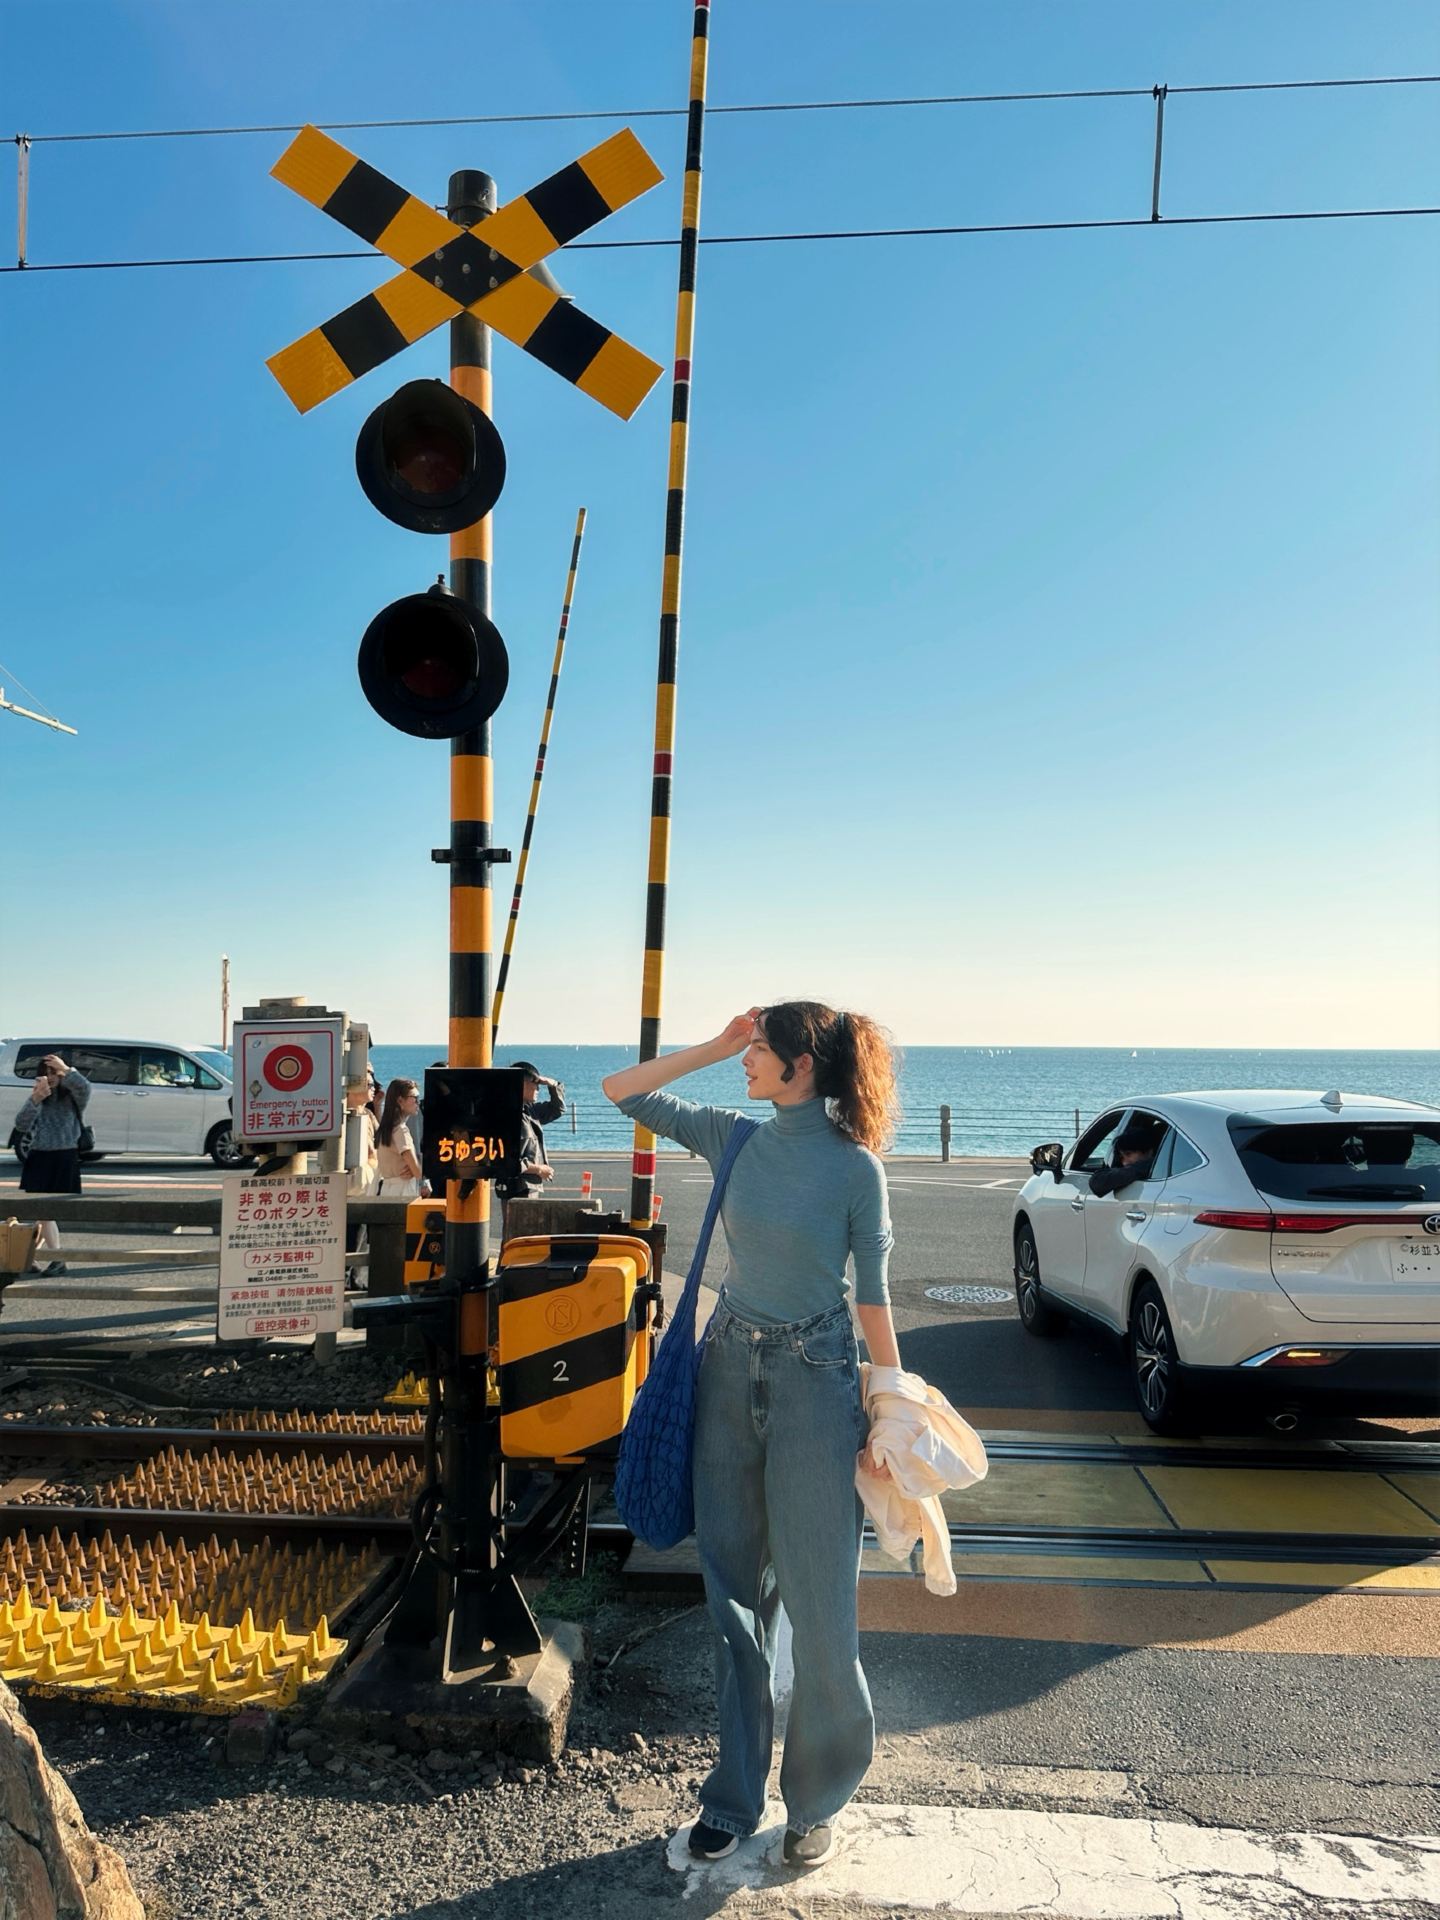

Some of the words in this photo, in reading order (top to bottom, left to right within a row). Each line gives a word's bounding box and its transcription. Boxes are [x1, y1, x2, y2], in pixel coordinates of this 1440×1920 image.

[249, 1100, 297, 1110] Emergency
[301, 1098, 329, 1106] button
[247, 1109, 329, 1130] 非常ボタン
[438, 1136, 505, 1163] ちゅうい
[239, 1189, 328, 1206] 非常の際は
[237, 1205, 330, 1221] このボタンを
[252, 1251, 314, 1264] カメラ監視中
[254, 1317, 310, 1333] 监控录像中
[552, 1360, 570, 1382] 2
